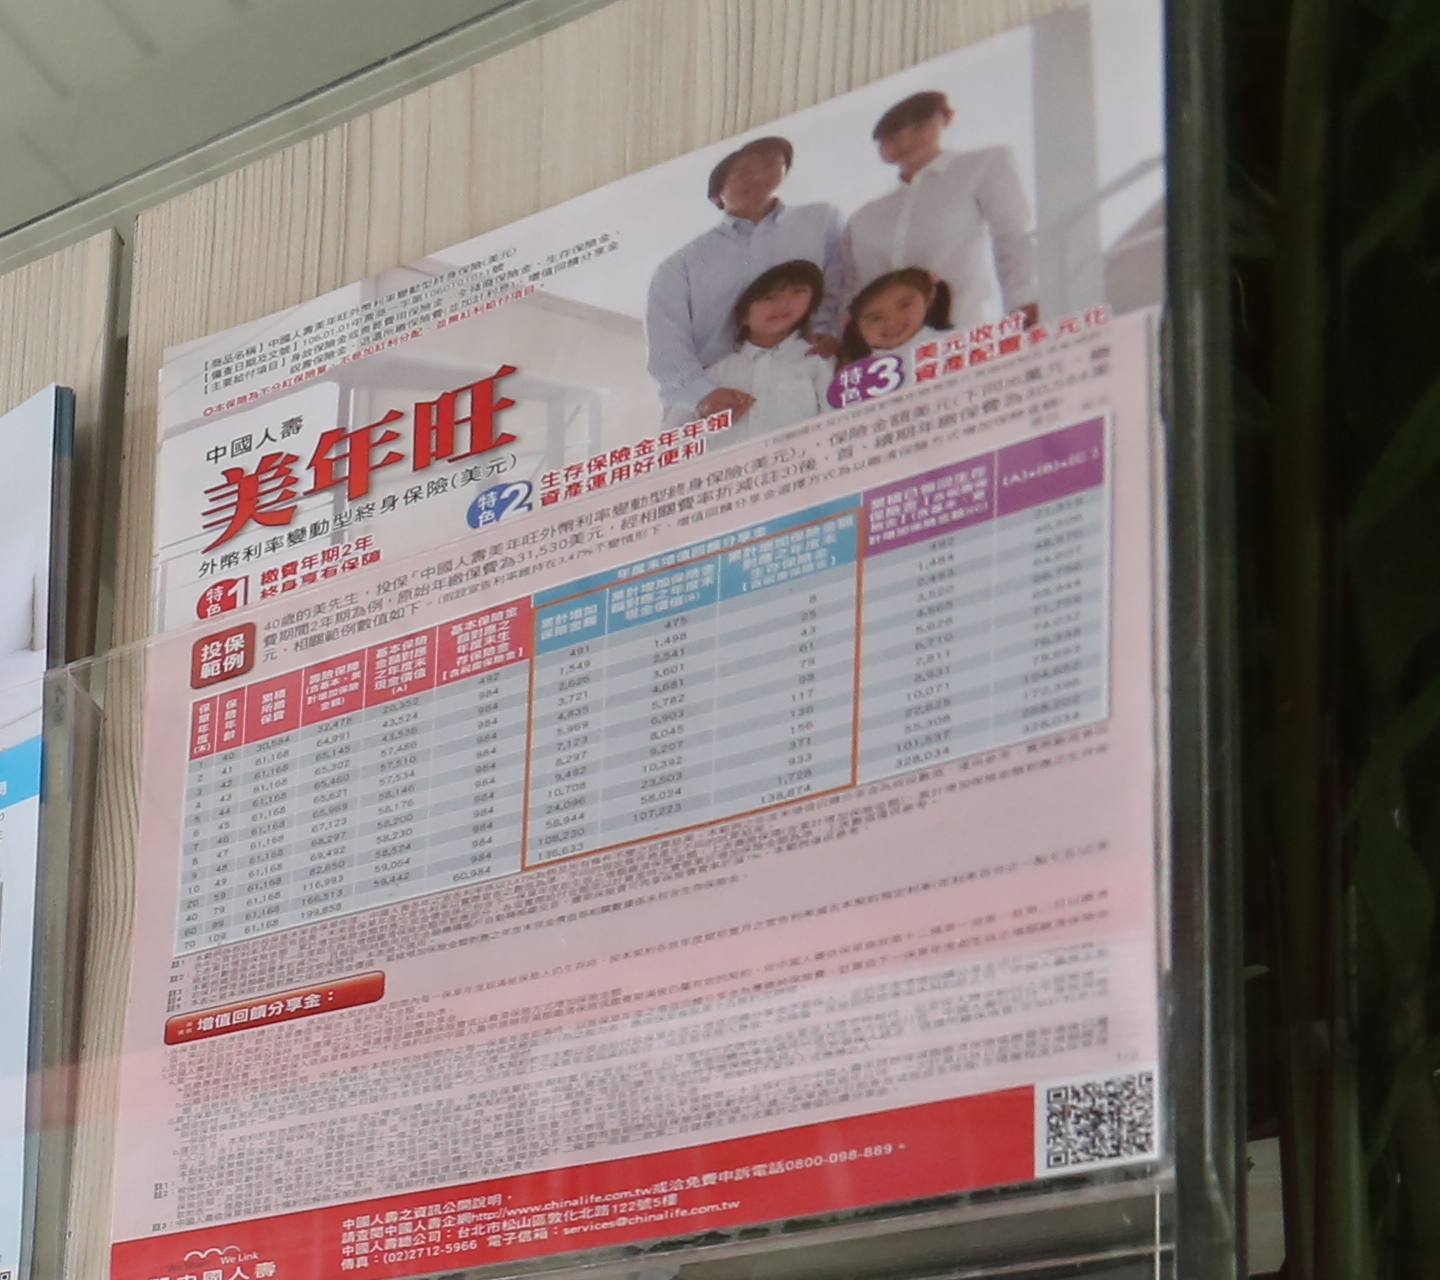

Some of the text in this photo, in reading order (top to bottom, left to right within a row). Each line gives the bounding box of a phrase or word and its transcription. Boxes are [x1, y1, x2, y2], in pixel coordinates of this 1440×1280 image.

[867, 356, 903, 397] 3
[201, 365, 519, 554] 美年旺
[206, 416, 303, 465] 中國人壽
[541, 410, 731, 490] 生存保險金年年領
[496, 481, 534, 514] 2
[201, 634, 245, 661] 投保
[201, 655, 244, 680] 範例
